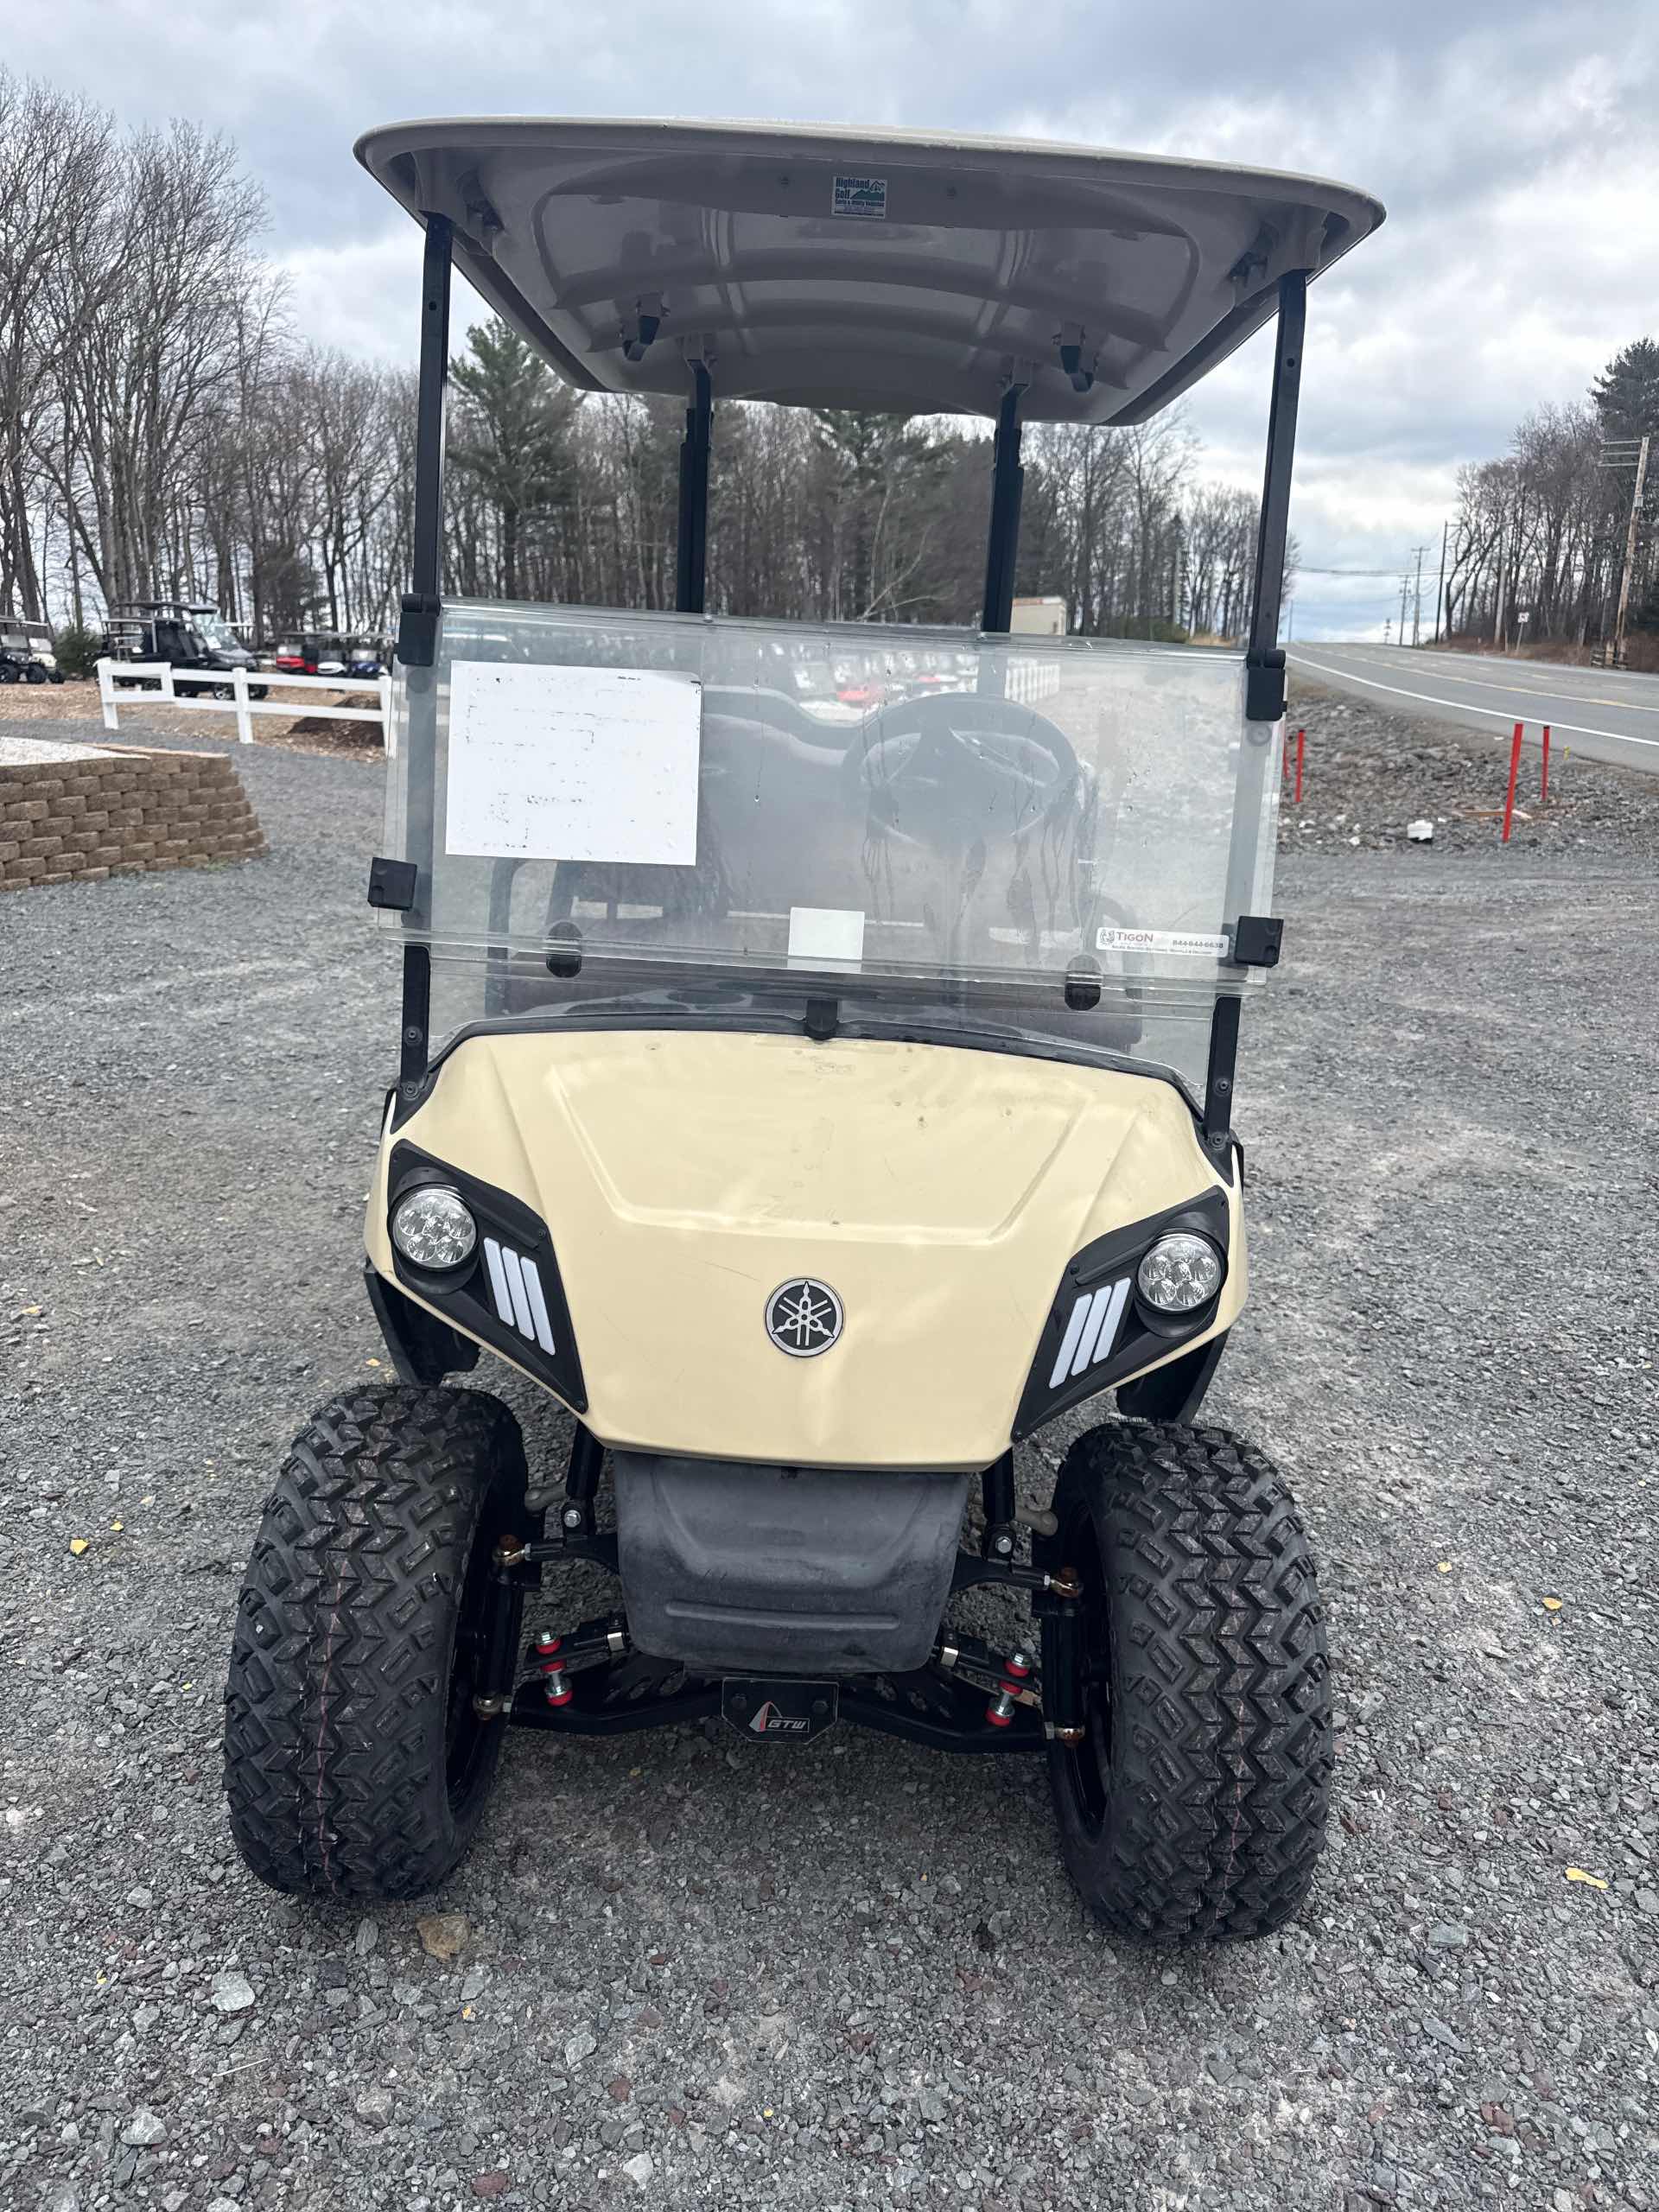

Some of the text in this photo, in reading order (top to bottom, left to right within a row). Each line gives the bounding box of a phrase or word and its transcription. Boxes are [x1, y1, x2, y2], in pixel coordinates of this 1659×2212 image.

[836, 177, 869, 188] Highland
[836, 189, 850, 199] Golf
[1116, 931, 1154, 943] TIGON
[768, 1719, 807, 1729] GTW
